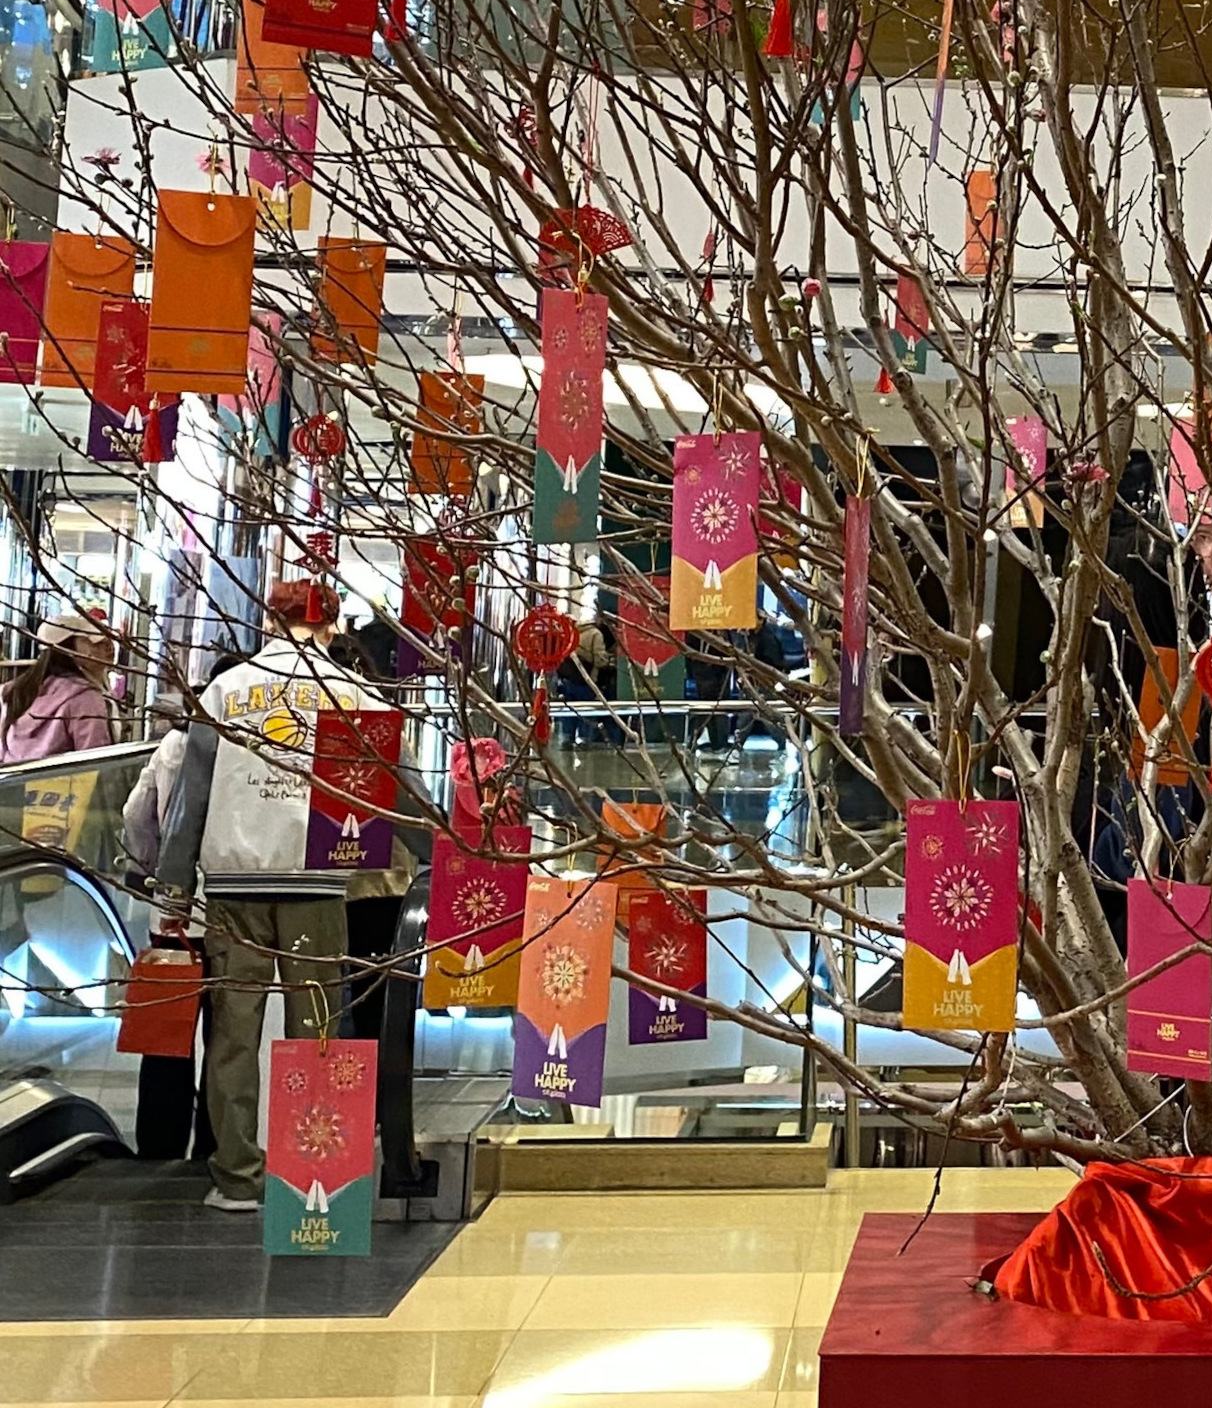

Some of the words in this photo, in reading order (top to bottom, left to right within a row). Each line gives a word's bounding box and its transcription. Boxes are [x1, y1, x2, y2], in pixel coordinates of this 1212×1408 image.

[700, 594, 722, 606] LIVE
[692, 605, 733, 619] HAPPY
[336, 841, 359, 851] LIVE
[328, 850, 368, 861] HAPPY
[459, 975, 485, 987] LIVE
[449, 984, 496, 999] HAPPY
[943, 990, 973, 1004] LIVE
[933, 1002, 984, 1017] HAPPY
[655, 1014, 677, 1025] LIVE
[648, 1023, 685, 1035] HAPPY
[543, 1061, 568, 1077] LIVE
[534, 1073, 577, 1092] HAPPY
[301, 1218, 329, 1231] LIVE
[291, 1230, 340, 1244] HAPPY
